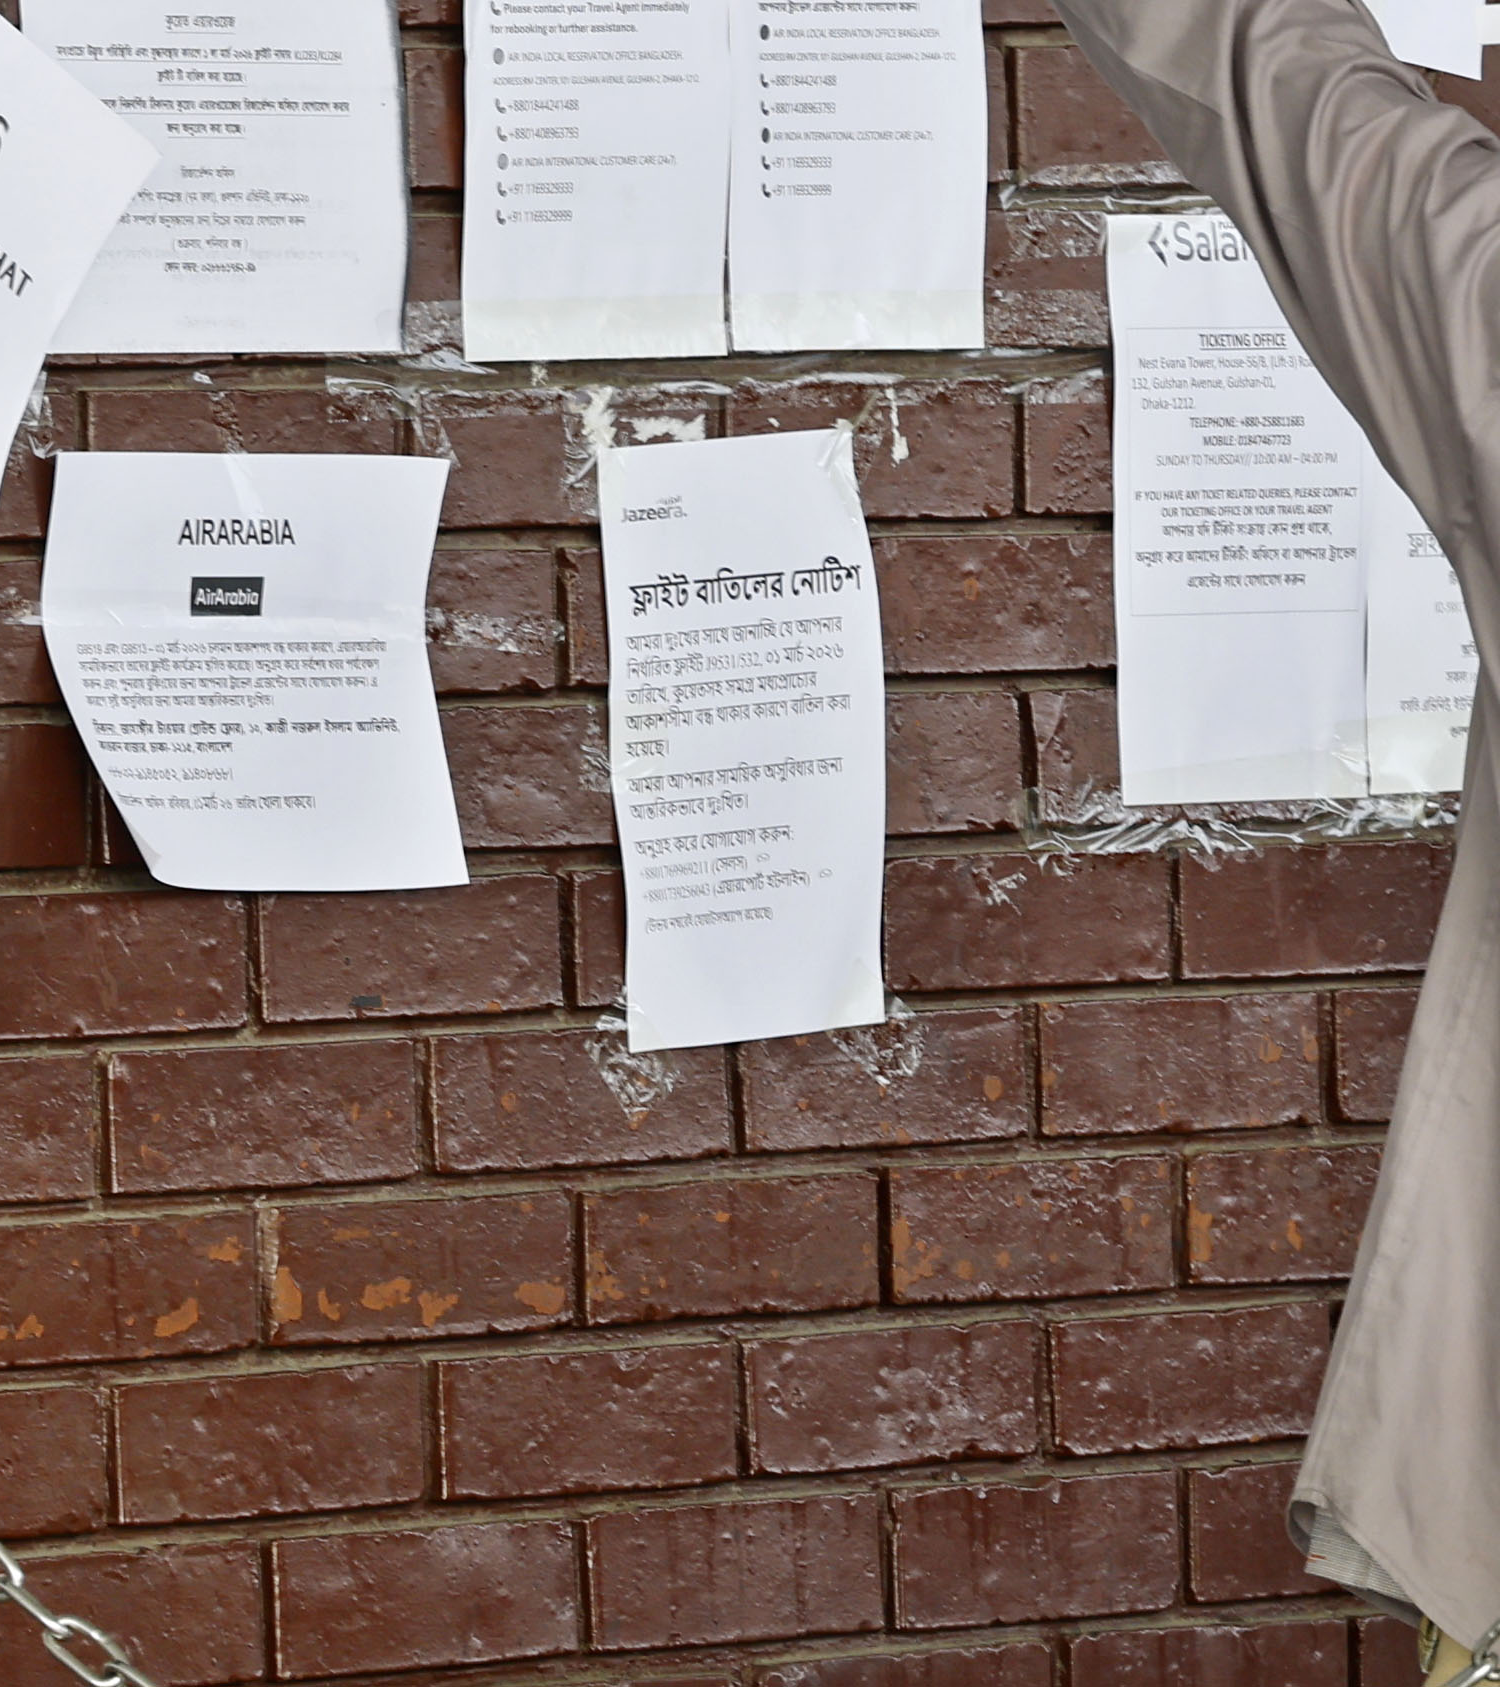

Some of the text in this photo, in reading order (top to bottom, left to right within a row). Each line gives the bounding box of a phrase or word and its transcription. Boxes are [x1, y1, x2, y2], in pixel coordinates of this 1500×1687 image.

[1199, 333, 1287, 347] TICKETING OFFICE
[179, 519, 295, 545] AIRARABIA
[194, 588, 259, 606] AirArabia
[629, 556, 860, 616] ফ্লাইট বাতিলের নোটিশ
